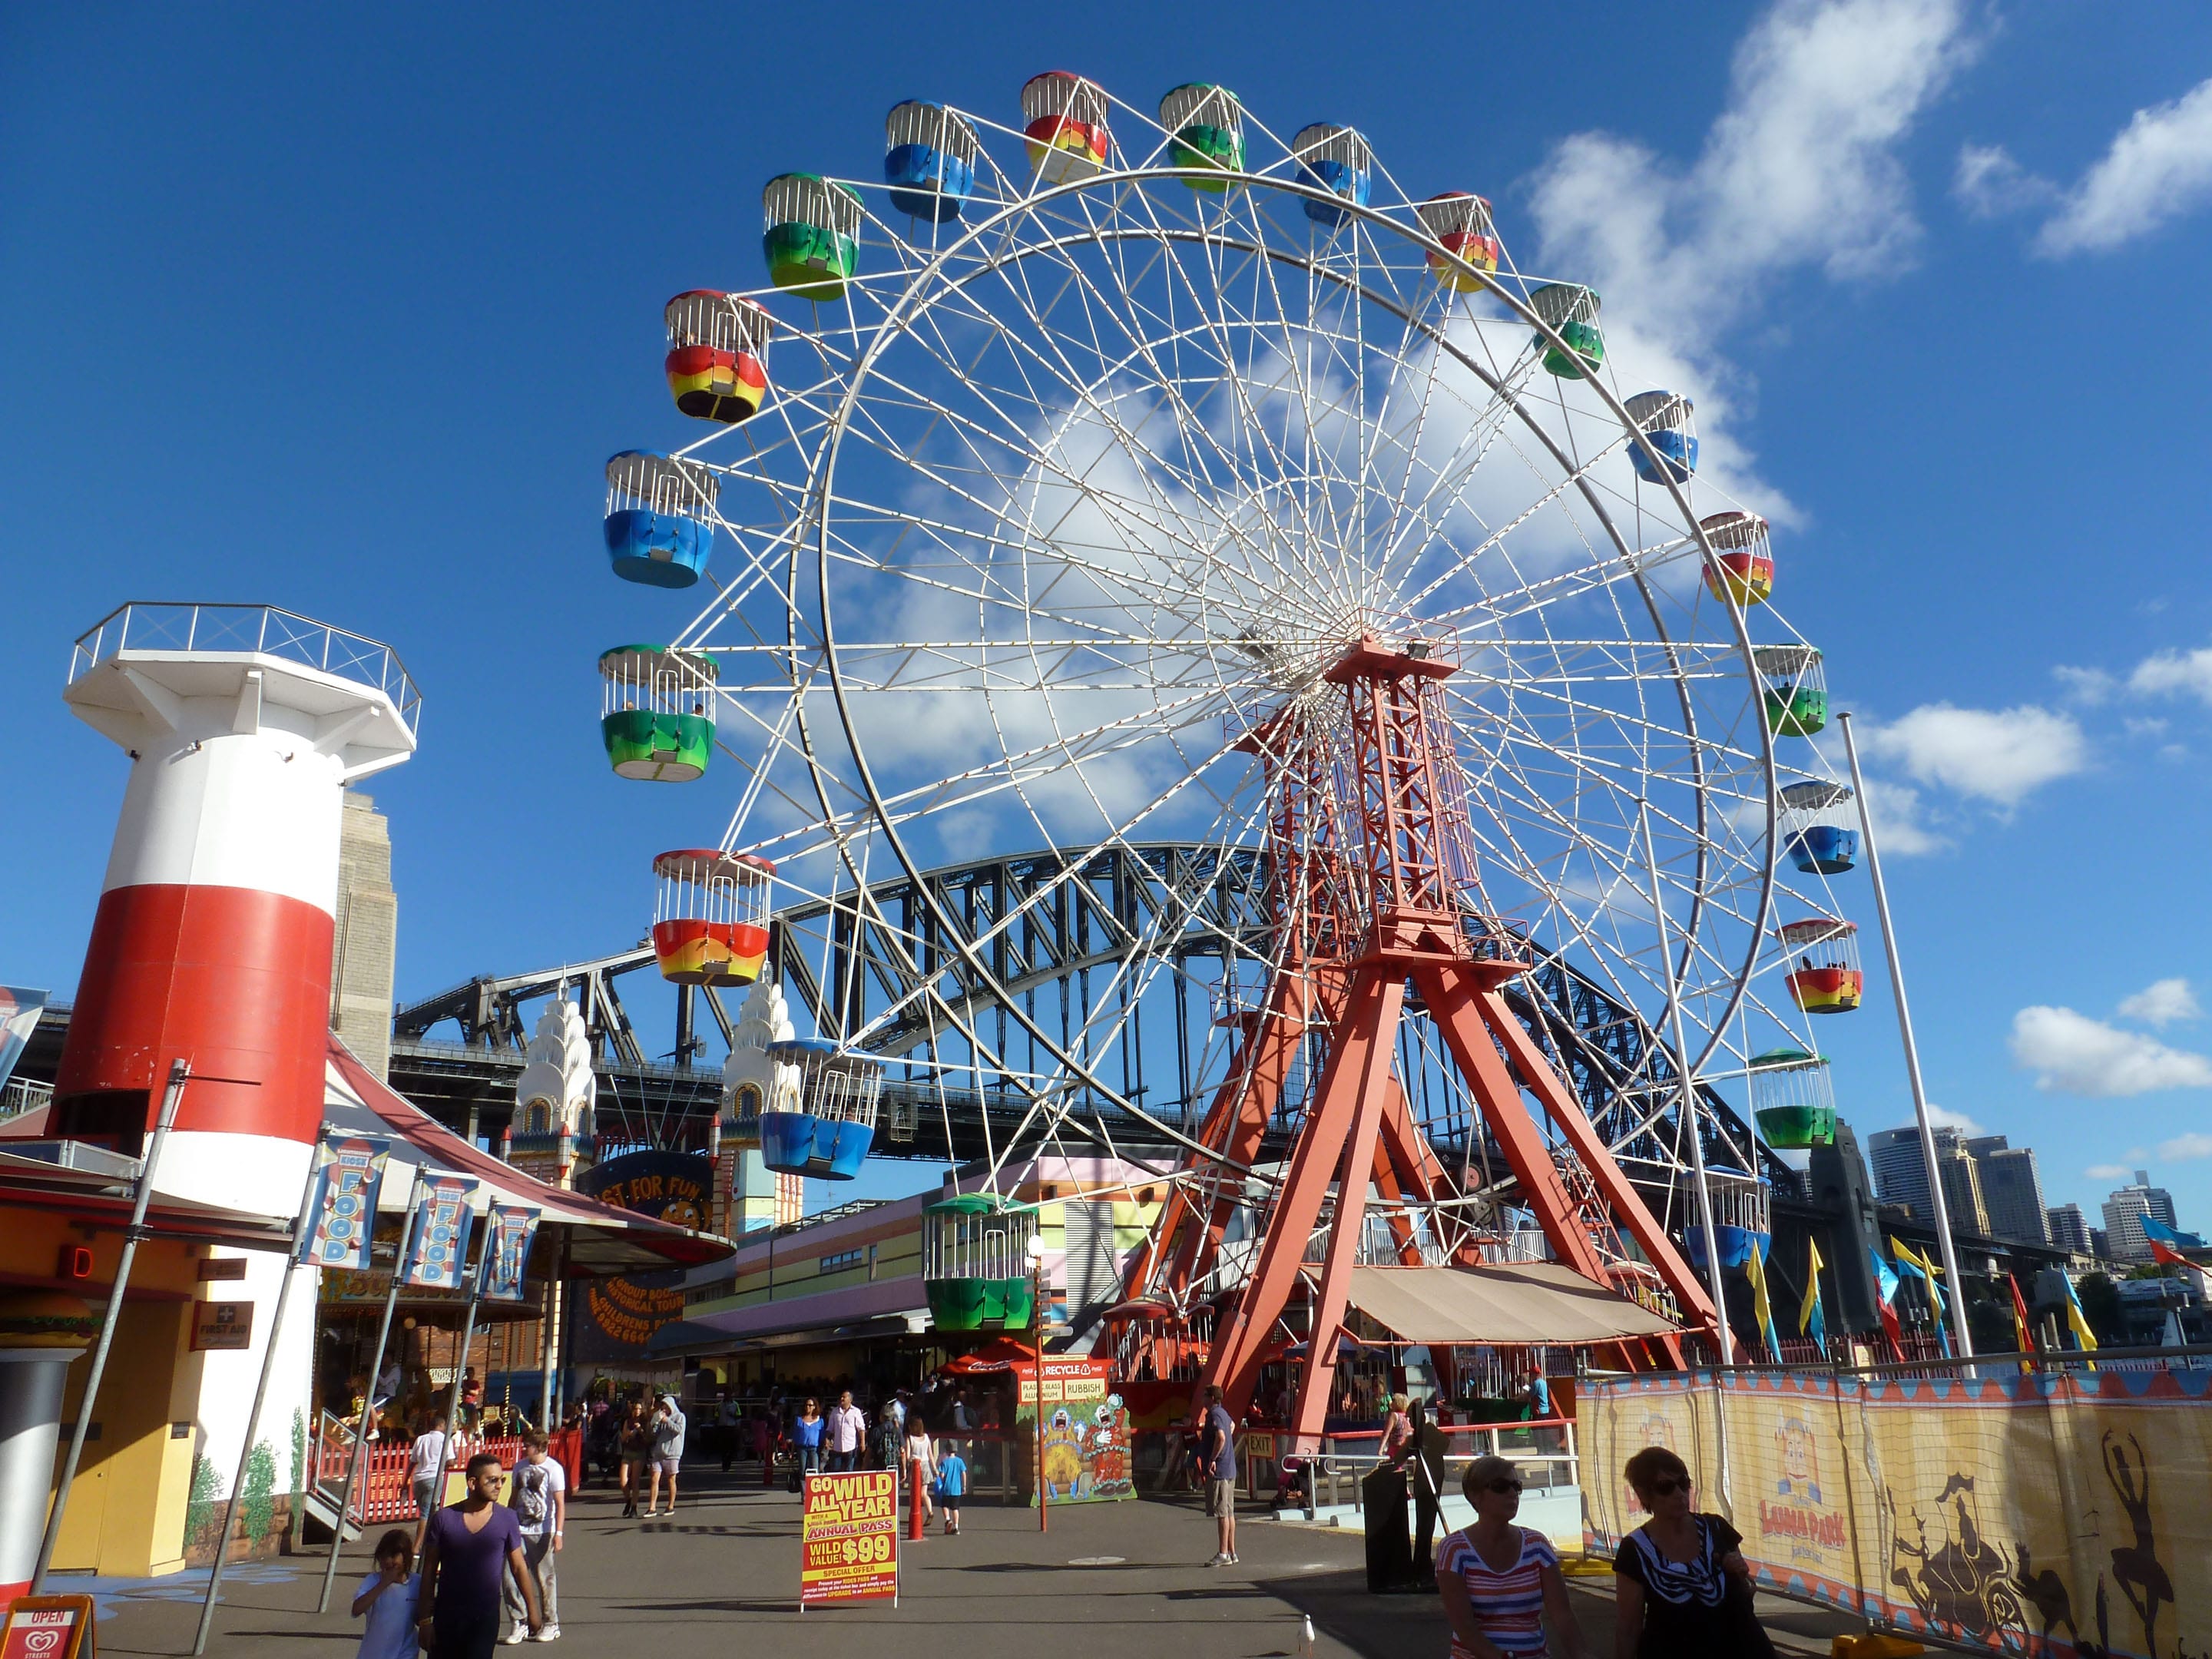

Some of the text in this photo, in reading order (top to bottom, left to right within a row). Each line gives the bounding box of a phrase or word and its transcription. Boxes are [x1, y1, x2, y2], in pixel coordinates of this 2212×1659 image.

[340, 1155, 368, 1167] KIOSK
[629, 1174, 664, 1204] FOR
[668, 1176, 702, 1199] FUN
[323, 1171, 362, 1263] FOOD
[422, 1205, 456, 1282] FOOD
[607, 1280, 654, 1313] HISTORICAL
[616, 1277, 648, 1300] GROUP
[599, 1296, 651, 1331] CHILDRENS
[200, 1324, 248, 1335] FIRST AID
[598, 1313, 623, 1339] 9922
[1045, 1365, 1080, 1376] RECYCLE
[1025, 1391, 1058, 1399] ALUNIUM
[1068, 1383, 1101, 1394] RUBBISH
[1250, 1435, 1271, 1452] EXIT
[810, 1473, 892, 1502] GO WILD
[810, 1494, 891, 1521] ALL YEAR
[806, 1519, 893, 1541] ANNUAL PASS
[1758, 1499, 1846, 1550] LUNA PARK
[810, 1535, 890, 1565] WILD $99
[810, 1553, 843, 1567] VALUE!
[823, 1565, 876, 1578] SPECIAL OFFER
[828, 1589, 852, 1598] UPGRADE
[31, 1611, 65, 1624] OPEN
